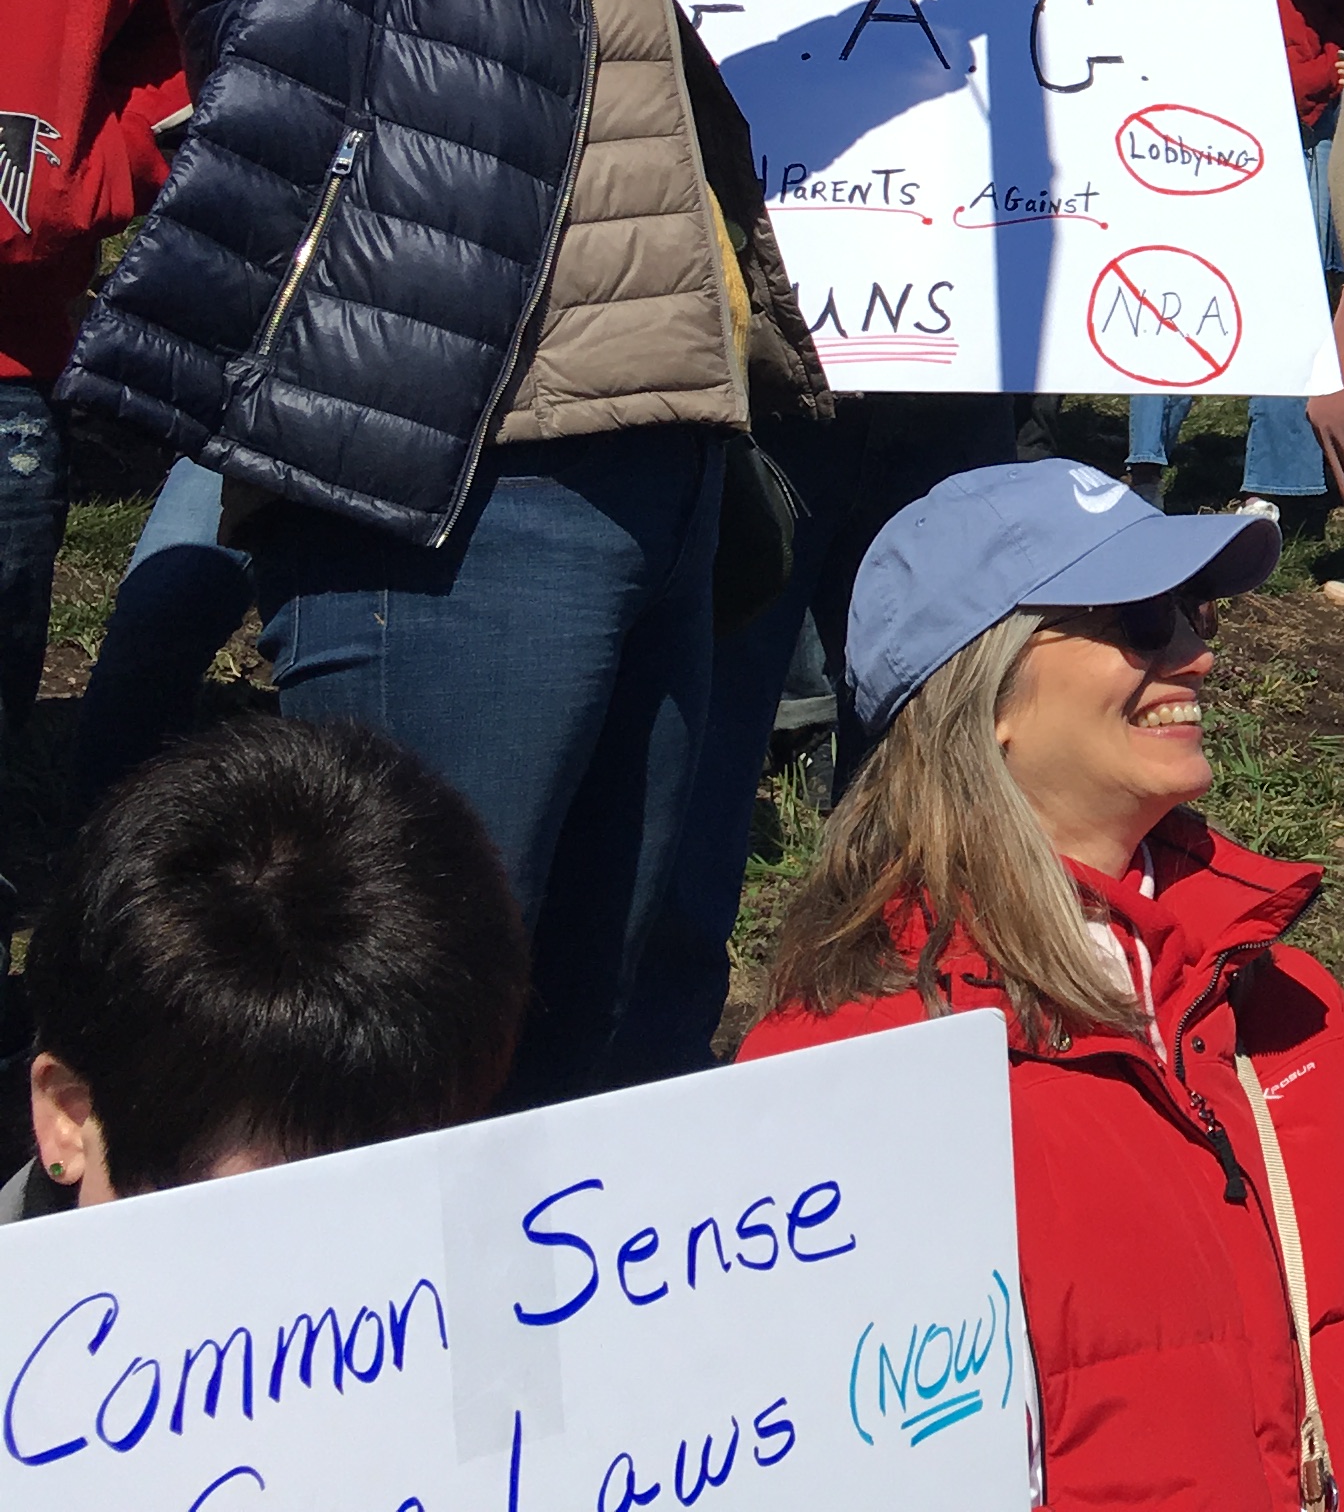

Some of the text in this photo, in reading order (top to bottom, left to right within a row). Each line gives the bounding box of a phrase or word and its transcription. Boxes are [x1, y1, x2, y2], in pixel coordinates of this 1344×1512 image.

[3, 1178, 857, 1467] Common Sense
[849, 1268, 1014, 1447] (NOW)
